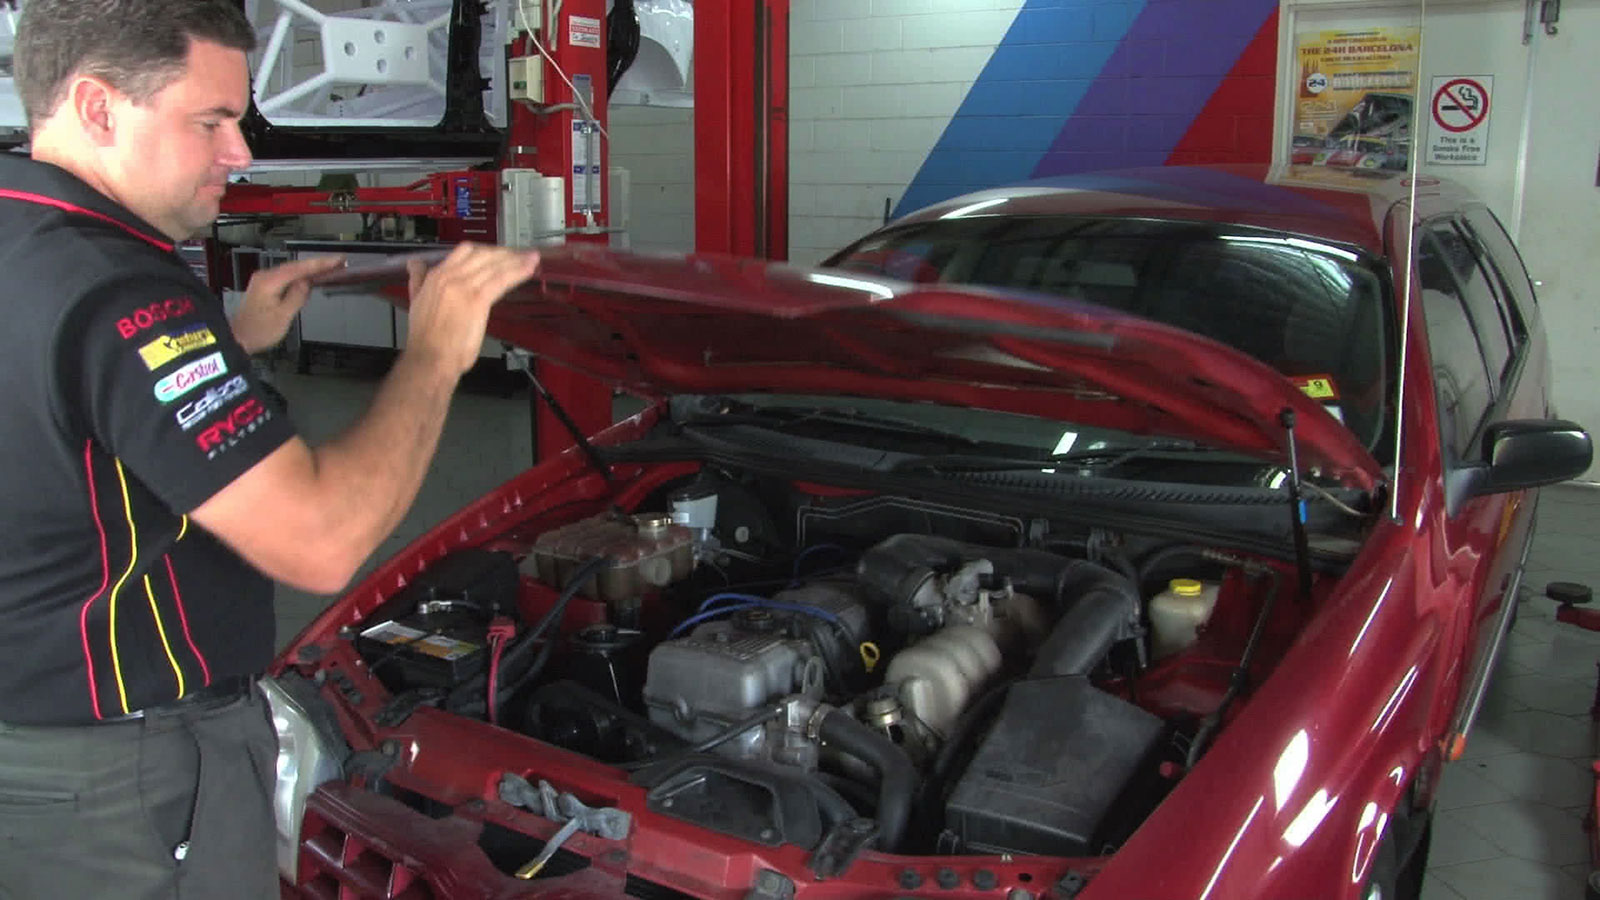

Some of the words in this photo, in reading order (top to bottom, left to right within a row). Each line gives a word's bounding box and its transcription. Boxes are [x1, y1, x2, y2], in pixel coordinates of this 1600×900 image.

[1300, 47, 1321, 55] THE
[1348, 43, 1414, 54] BARCELONA
[1308, 78, 1326, 88] 24
[1439, 136, 1457, 144] This
[1433, 153, 1478, 161] Workplace
